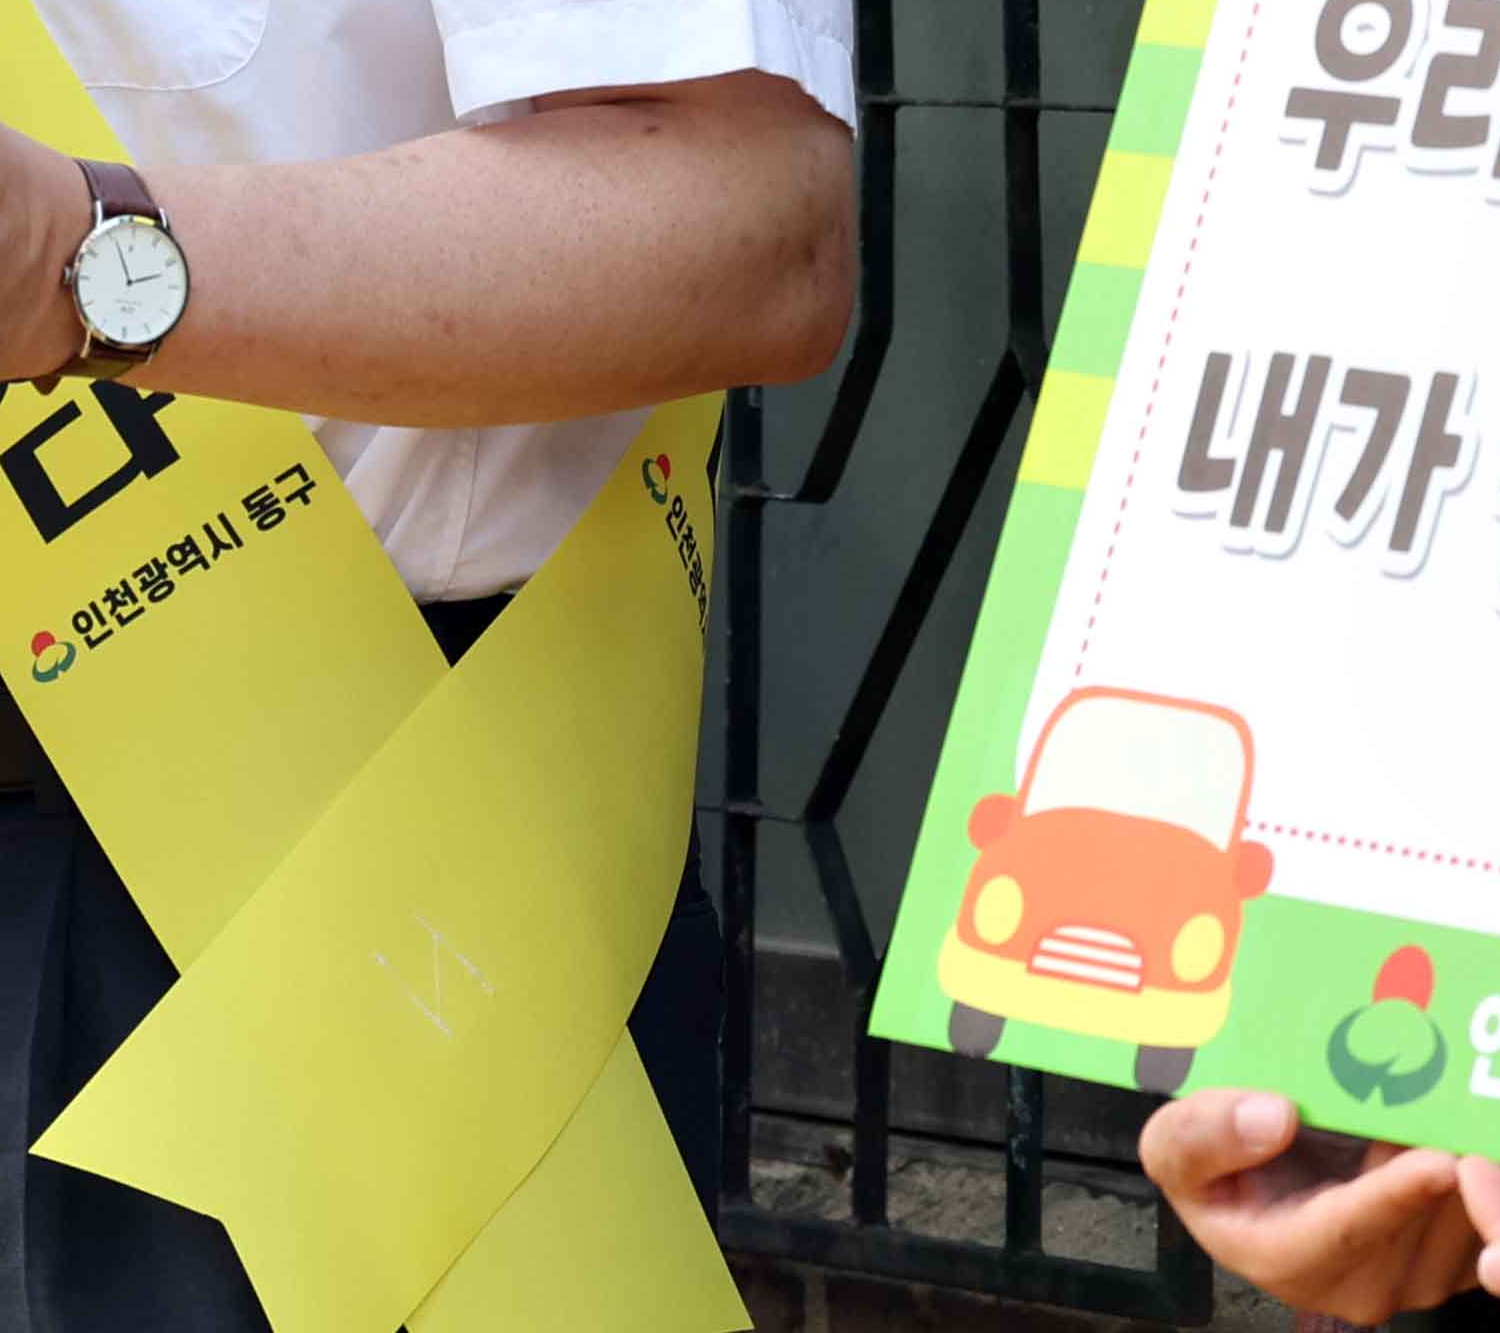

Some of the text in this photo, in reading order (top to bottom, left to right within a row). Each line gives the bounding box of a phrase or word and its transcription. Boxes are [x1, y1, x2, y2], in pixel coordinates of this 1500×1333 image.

[1175, 350, 1461, 553] 내가
[71, 463, 318, 651] 인천광역시 동구
